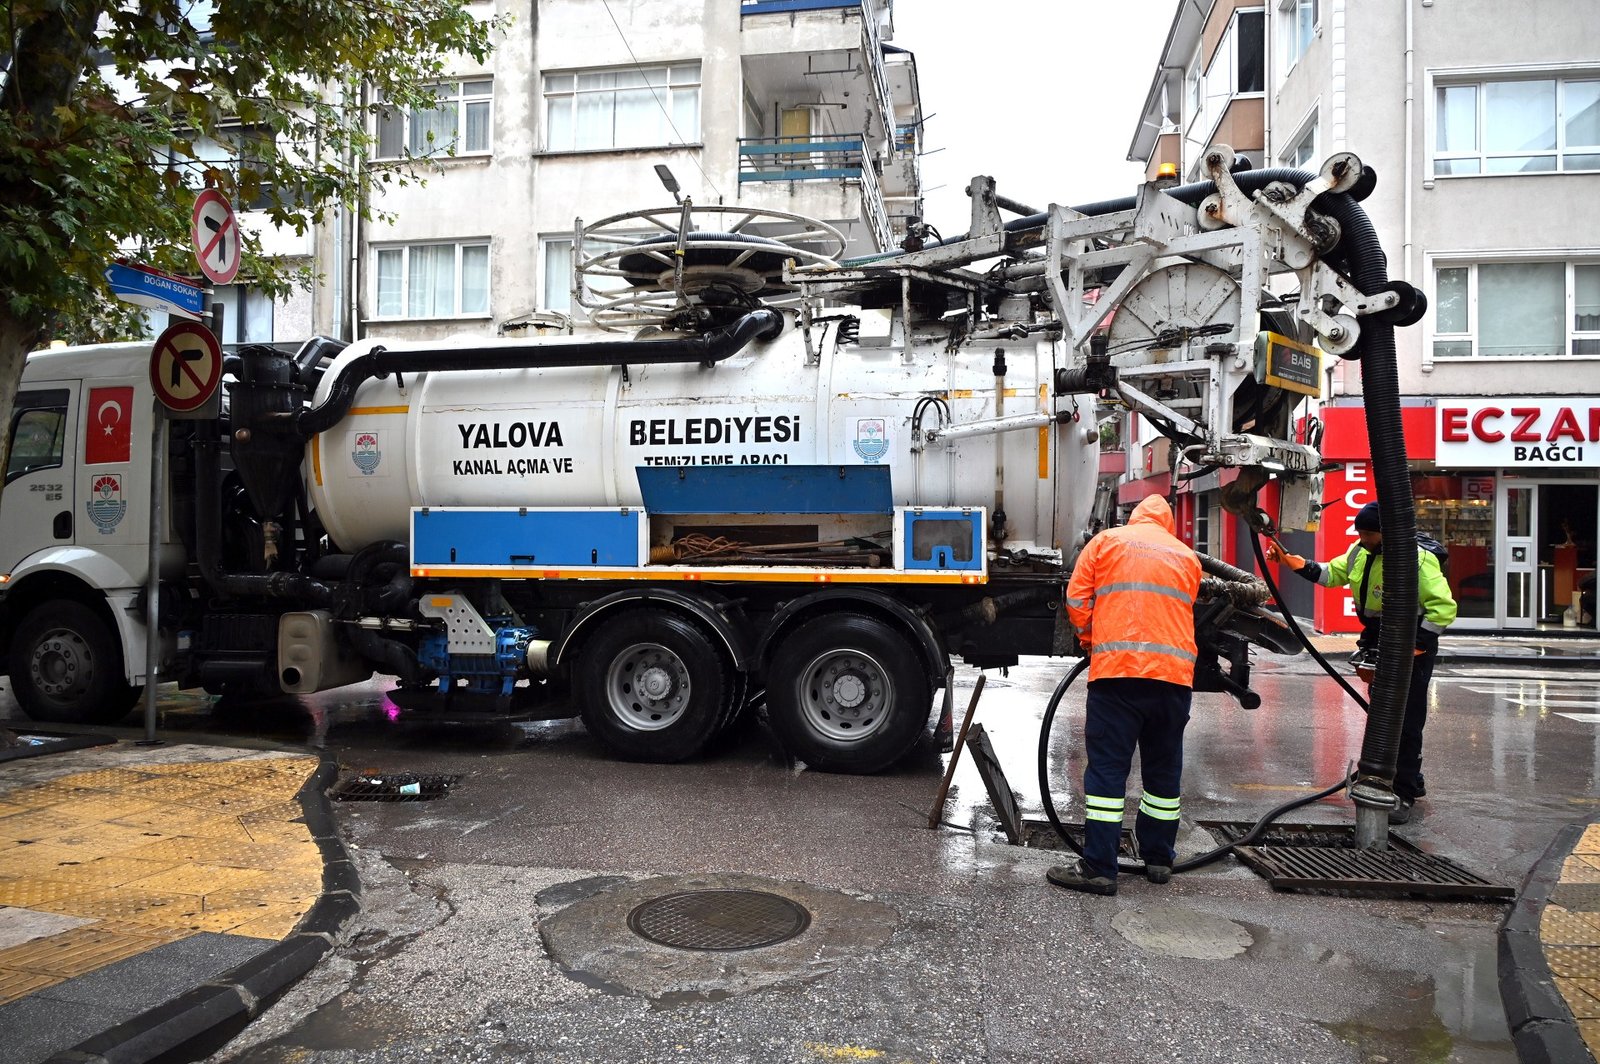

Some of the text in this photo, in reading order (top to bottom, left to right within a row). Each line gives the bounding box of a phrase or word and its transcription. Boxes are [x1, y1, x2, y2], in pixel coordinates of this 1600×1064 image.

[172, 283, 198, 298] SOKAK
[458, 421, 564, 449] YALOVA
[1514, 443, 1583, 462] BAĞCI
[453, 460, 503, 475] KANAL
[507, 458, 550, 478] AÇMA
[553, 457, 574, 473] VE
[29, 484, 63, 492] 2532
